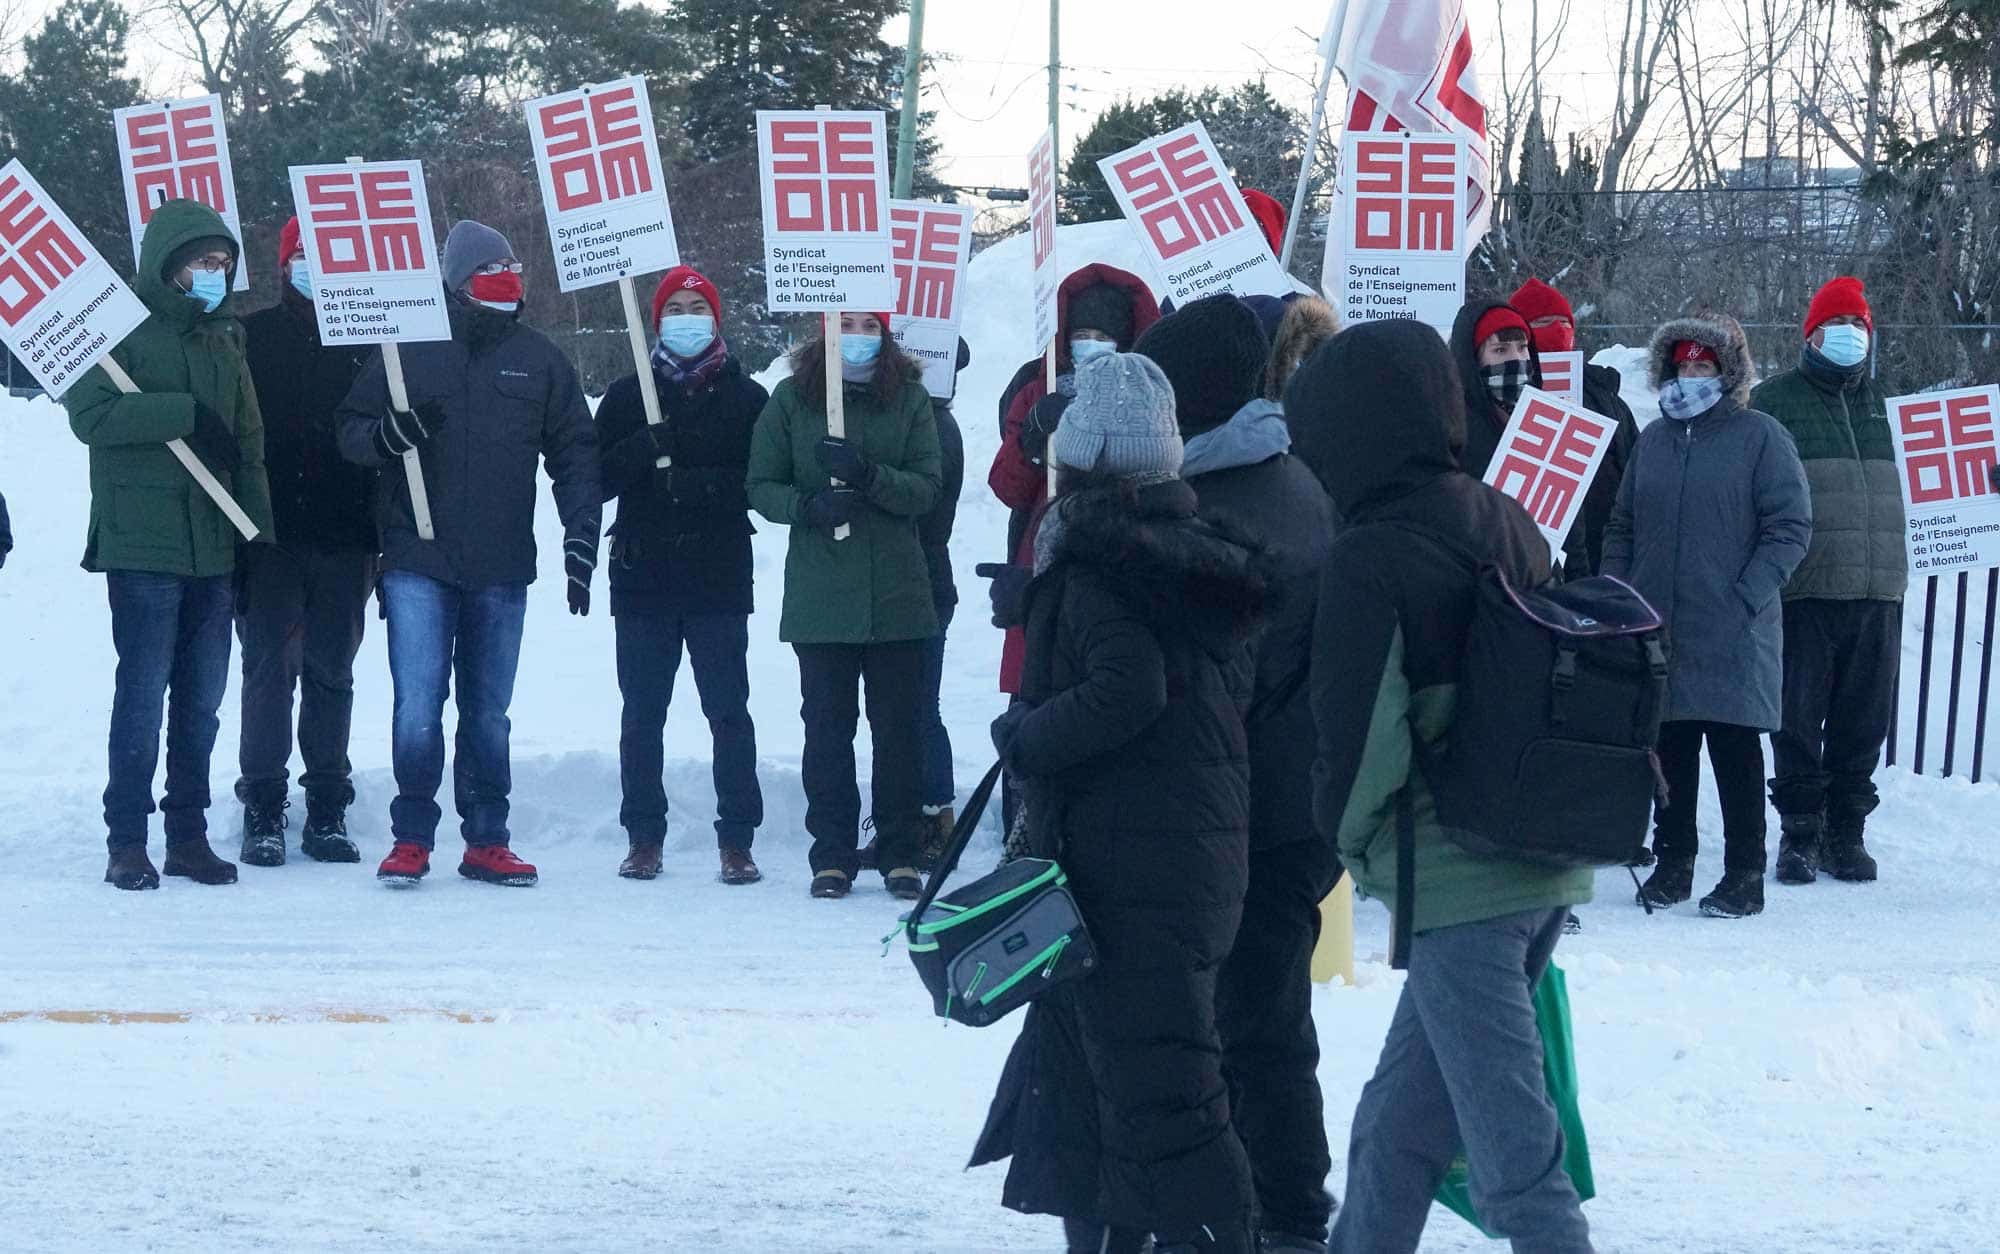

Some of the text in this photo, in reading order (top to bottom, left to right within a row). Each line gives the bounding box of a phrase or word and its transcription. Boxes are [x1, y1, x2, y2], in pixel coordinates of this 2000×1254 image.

[126, 105, 218, 168] SE
[539, 86, 642, 157] SE
[770, 121, 875, 174] SE
[1357, 141, 1456, 194] SE
[550, 141, 653, 212] OM
[1113, 133, 1219, 211] SE
[134, 161, 226, 224] OM
[304, 170, 417, 223] SE
[774, 179, 879, 232] OM
[0, 174, 48, 257] E
[558, 219, 607, 239] Syndicat
[1140, 182, 1245, 261] OM
[1355, 198, 1455, 251] OM
[314, 222, 426, 274] OM
[561, 221, 664, 254] de l'Enseignement
[564, 246, 620, 267] de l'Ouest
[774, 248, 826, 260] Syndicat
[567, 257, 632, 282] de Montréal
[775, 262, 884, 275] de l'Enseignement
[776, 277, 835, 288] de l'Ouest
[1168, 260, 1213, 284] Syndicat
[1176, 253, 1267, 298] de l'Enseignement
[1349, 265, 1400, 277] Syndicat
[1349, 279, 1456, 292] de l'Enseignement
[321, 287, 374, 299] Syndicat
[323, 298, 436, 312] de l'Enseignement
[776, 292, 846, 303] de Montréal
[1349, 294, 1406, 305] de l'Ouest
[20, 311, 64, 351] Syndicat
[32, 283, 117, 363] de l'Enseignement
[326, 313, 387, 324] de l'Ouest
[329, 325, 399, 338] de Montréal
[1348, 308, 1417, 321] de Montréal
[42, 329, 90, 375] de l'Ouest
[52, 332, 107, 386] de Montréal
[1510, 399, 1605, 476] SE
[1899, 394, 1994, 452] SE
[1493, 454, 1580, 530] OM
[1906, 446, 2000, 504] OM
[1910, 515, 1956, 529] Syndicat
[1912, 532, 1926, 543] de
[1914, 541, 1967, 556] de l'Ouest
[1916, 552, 1978, 569] de Montréal
